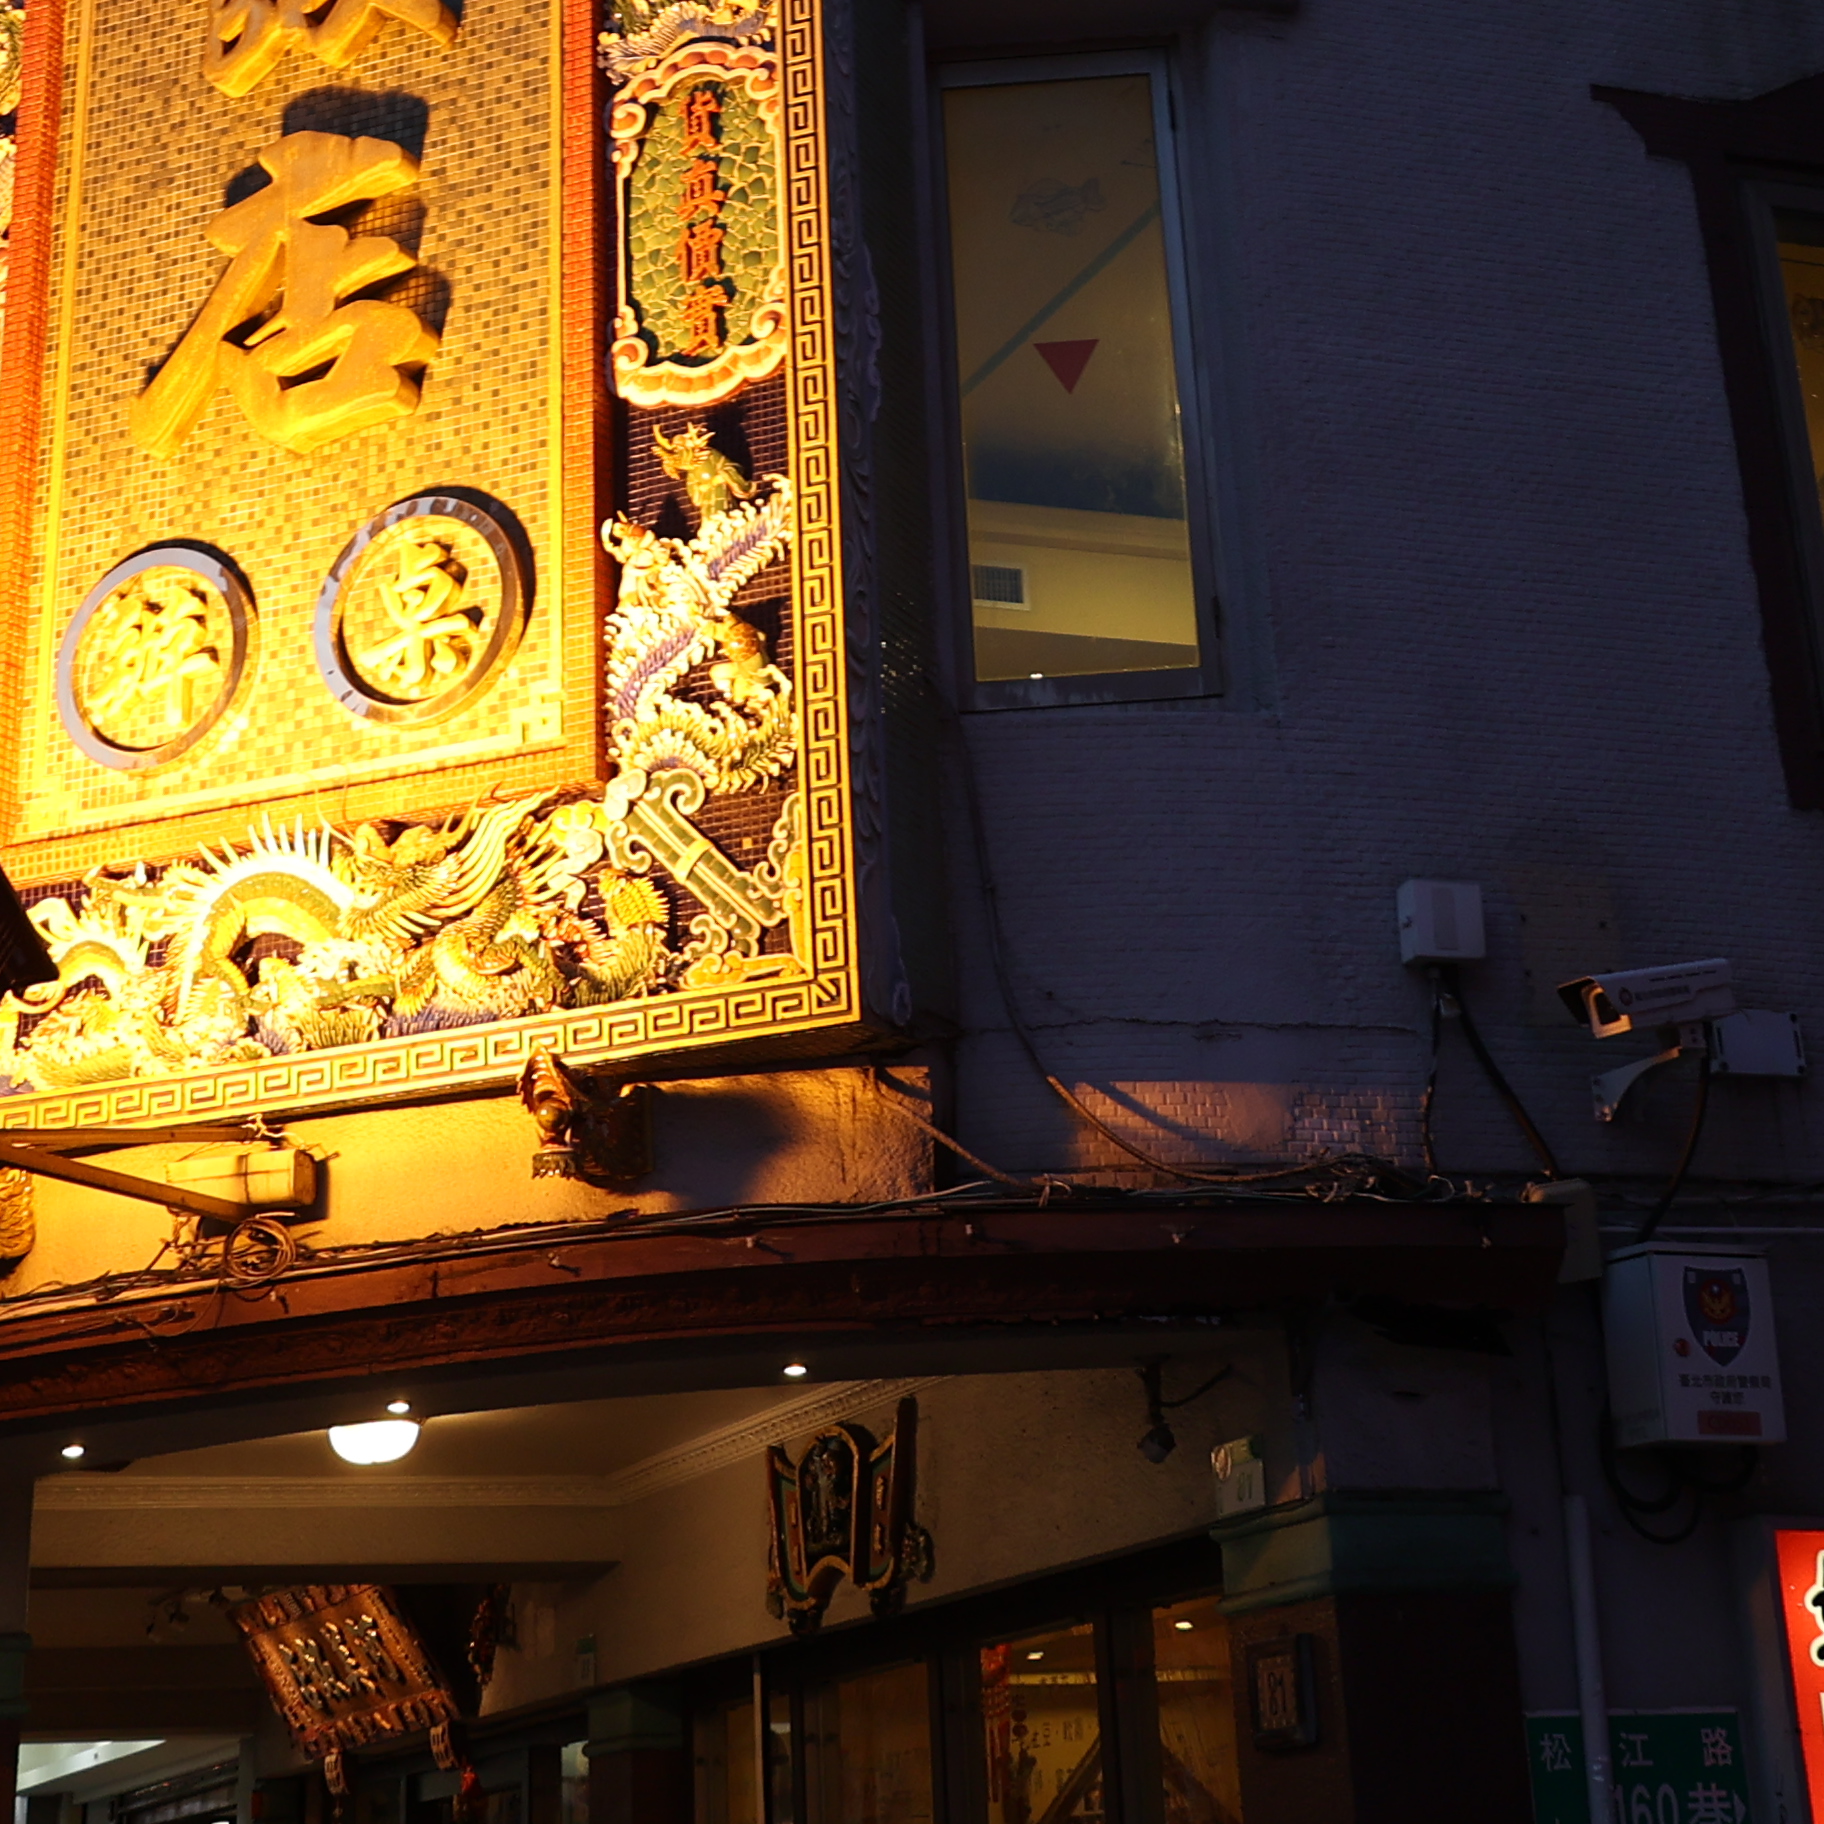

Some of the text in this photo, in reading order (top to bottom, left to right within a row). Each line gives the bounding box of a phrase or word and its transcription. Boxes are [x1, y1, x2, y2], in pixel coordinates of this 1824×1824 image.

[676, 91, 727, 357] 貨真價實
[1703, 1330, 1739, 1347] POLICE
[1539, 1727, 1733, 1772] 松江路
